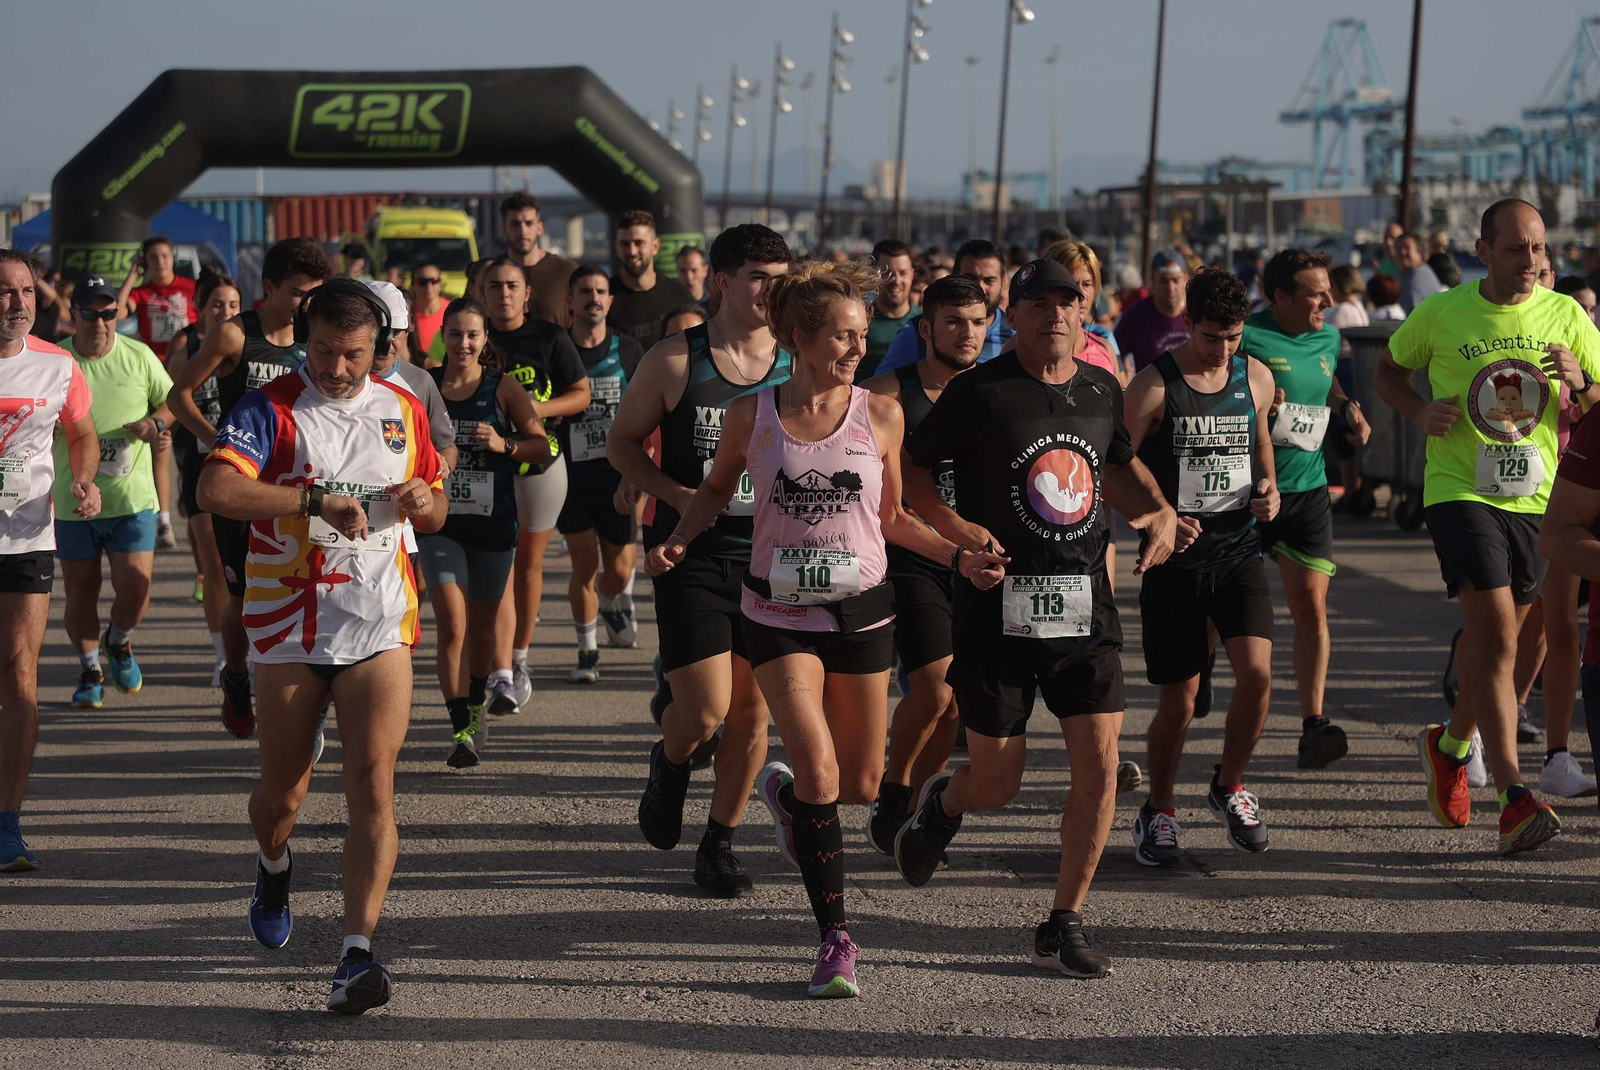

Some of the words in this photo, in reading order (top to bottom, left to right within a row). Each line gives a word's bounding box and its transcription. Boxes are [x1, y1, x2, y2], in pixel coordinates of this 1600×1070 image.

[312, 93, 448, 132] 42K
[367, 130, 442, 151] running
[1172, 416, 1216, 434] XXVI
[1216, 416, 1249, 424] CARRERA
[696, 428, 720, 438] VIRGE
[1216, 424, 1249, 433] POPULAR
[1175, 437, 1204, 446] VIRGEN
[1207, 437, 1221, 445] DEL
[1225, 436, 1248, 445] PILAR
[1011, 435, 1053, 469] CLINICA
[1056, 433, 1099, 467] MEDRANO
[1485, 444, 1518, 453] XXVI
[1188, 458, 1220, 466] XXVI
[1497, 459, 1529, 477] 129
[324, 481, 363, 493] XXVI
[1202, 471, 1231, 491] 175
[450, 483, 471, 499] 55
[780, 505, 848, 513] TRAIL
[1011, 485, 1051, 539] FERTILIDAD
[1054, 532, 1062, 541] &
[781, 549, 818, 558] XXVI
[796, 565, 831, 588] 110
[1012, 576, 1051, 586] XXVI
[754, 601, 764, 610] TU
[1030, 593, 1064, 615] 113
